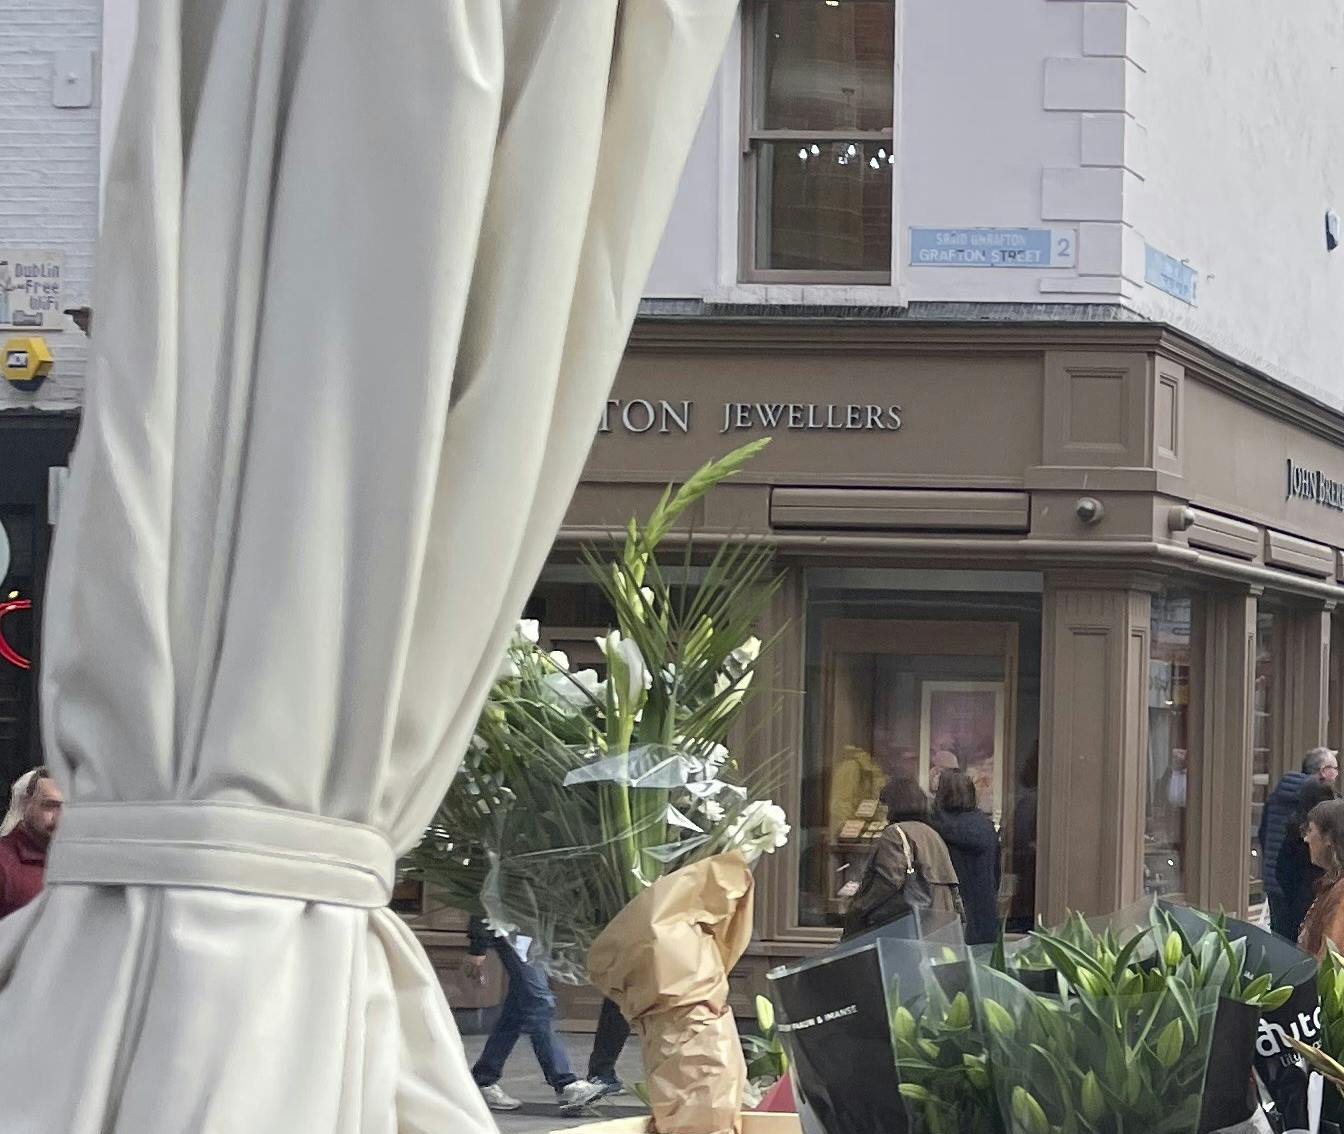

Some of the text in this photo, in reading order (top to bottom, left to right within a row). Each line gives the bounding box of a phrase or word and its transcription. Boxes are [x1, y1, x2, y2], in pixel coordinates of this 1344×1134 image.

[919, 238, 1071, 264] GRAFTON STREET 2
[719, 402, 903, 433] JEWELLERS
[1285, 459, 1317, 500] JOHN
